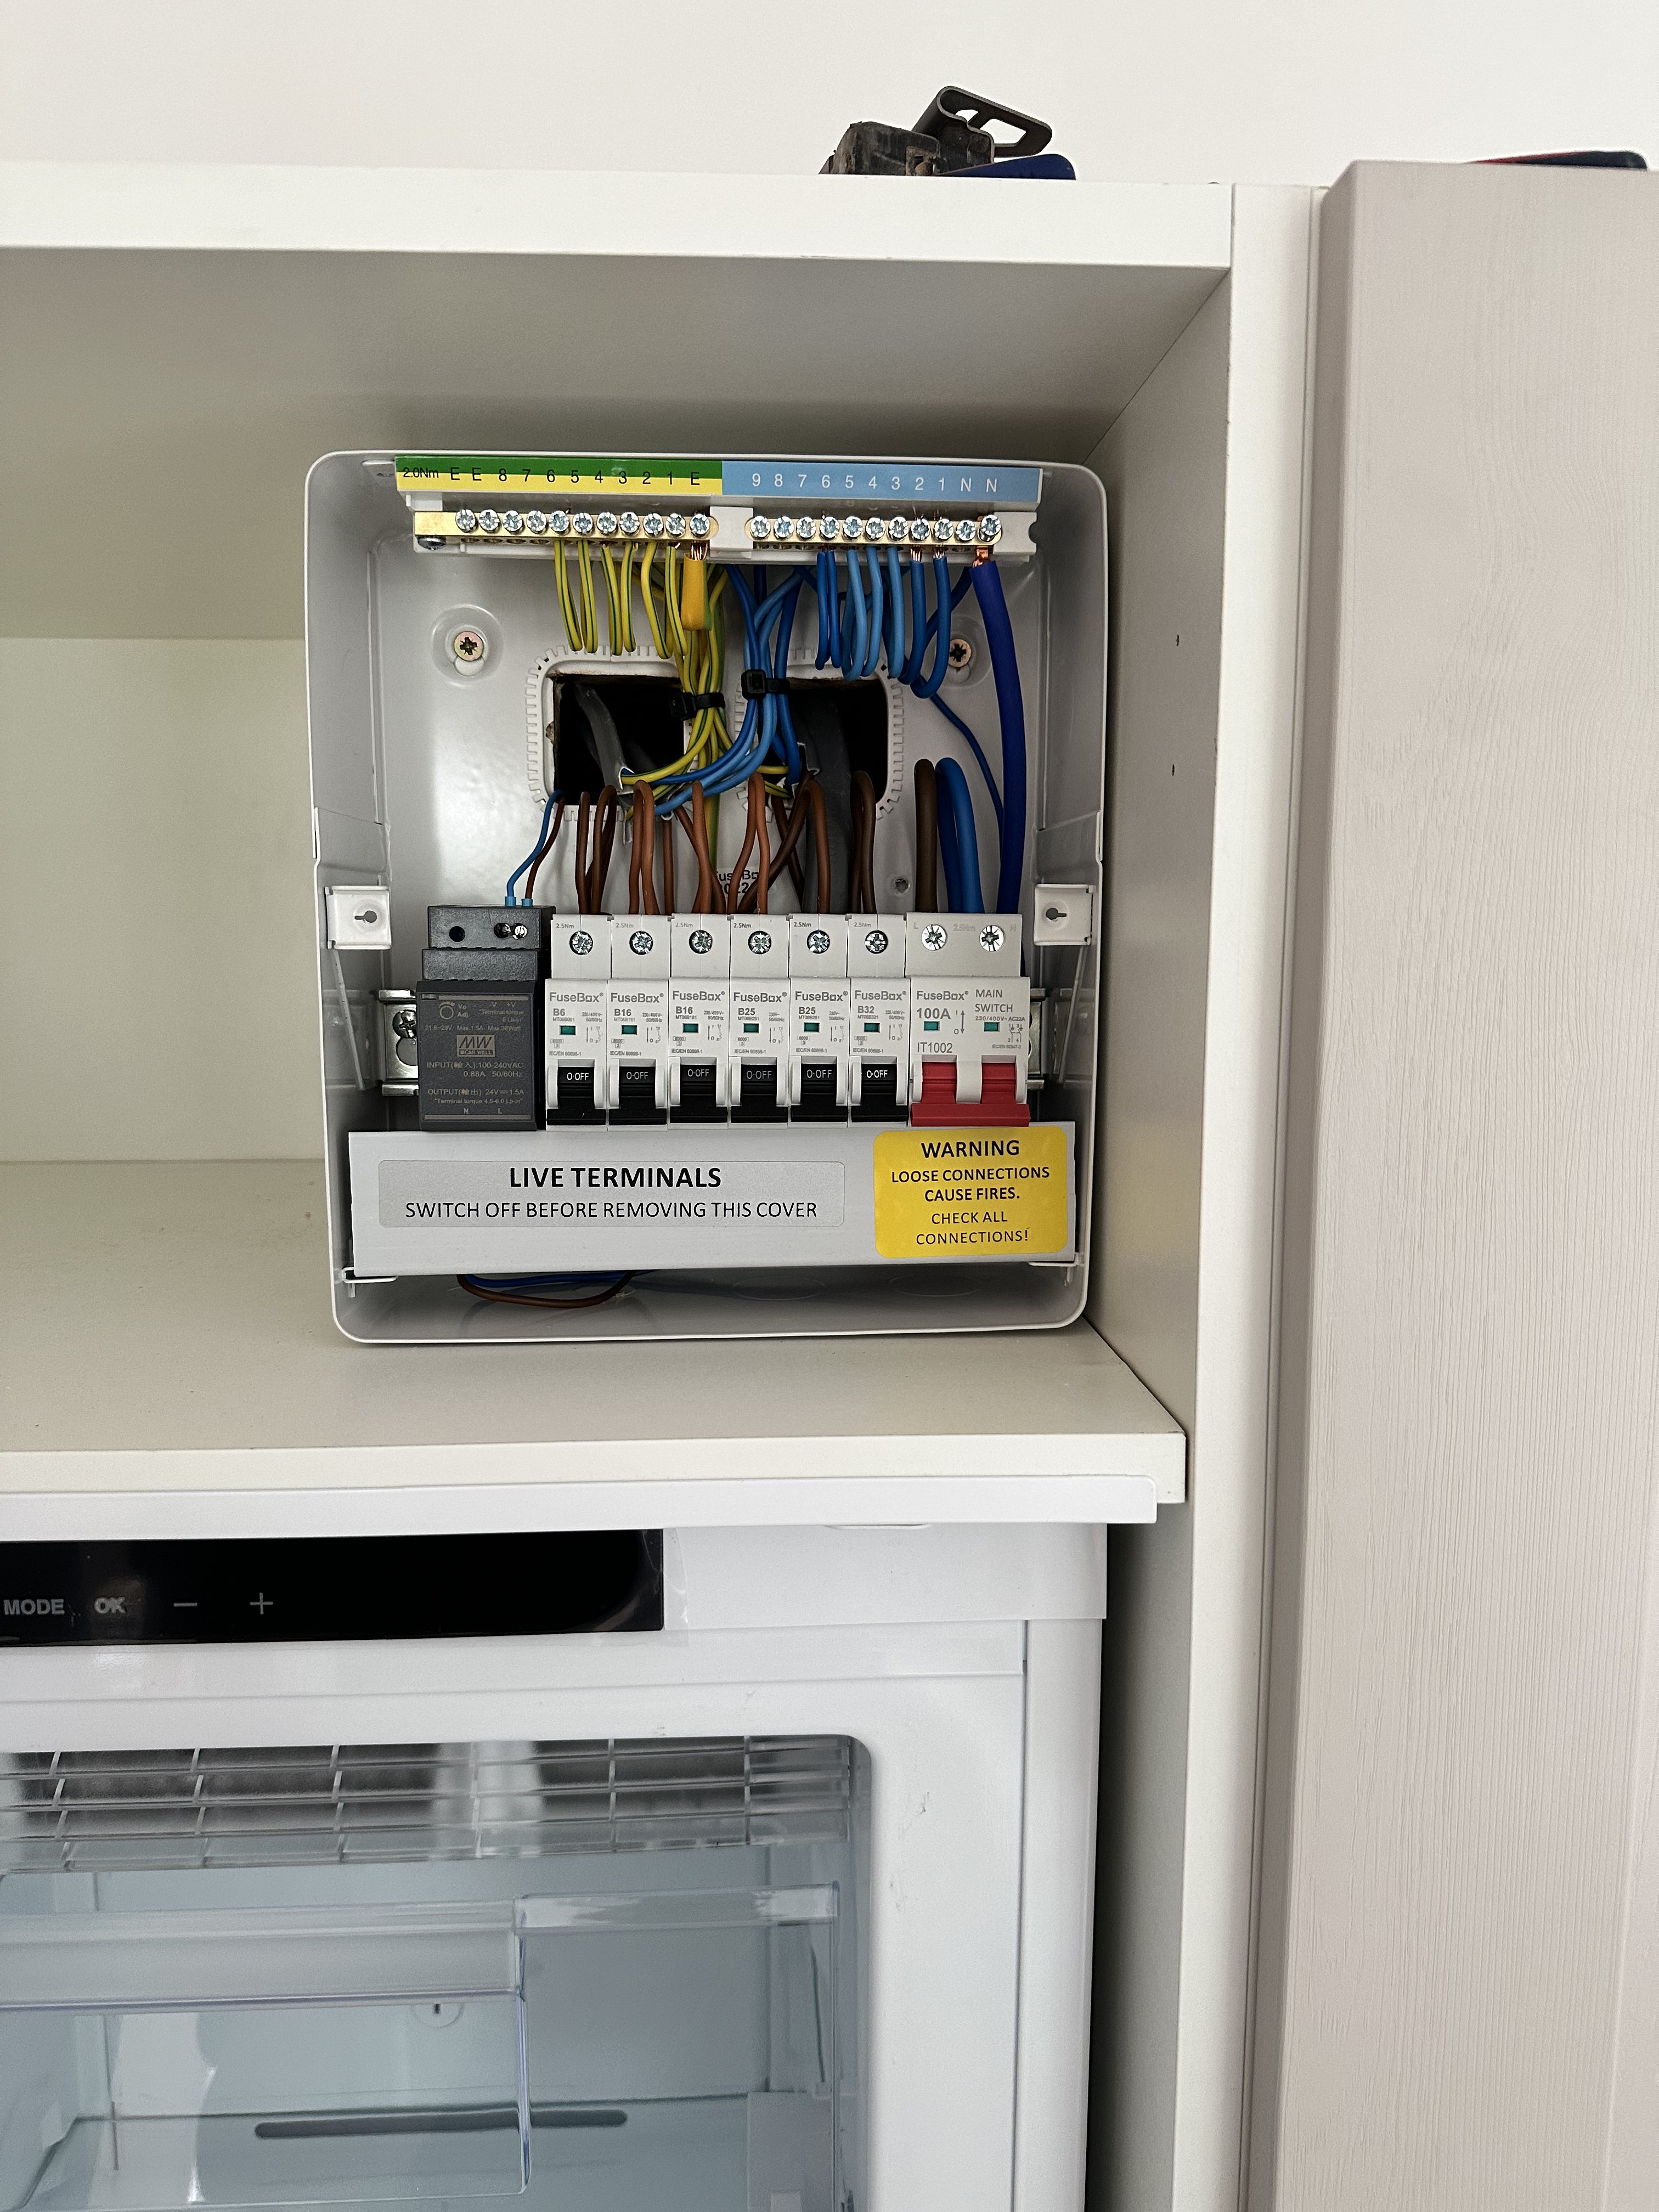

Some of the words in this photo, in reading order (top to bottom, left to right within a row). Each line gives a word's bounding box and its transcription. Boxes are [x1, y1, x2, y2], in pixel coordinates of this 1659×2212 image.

[403, 467, 439, 479] 2.0Nm
[450, 467, 460, 481] E
[472, 467, 482, 481] E
[498, 469, 507, 482] 8
[522, 469, 531, 482] 7
[546, 470, 555, 483] 6
[571, 470, 579, 483] 5
[595, 470, 604, 484] 4
[618, 471, 628, 484] 3
[642, 471, 651, 484] 2
[668, 472, 674, 484] 1
[691, 472, 699, 485] E
[752, 473, 761, 487] 9
[774, 474, 783, 487] 8
[798, 475, 807, 488] 7
[822, 475, 830, 488] 6
[845, 476, 854, 489] 5
[868, 476, 877, 489] 4
[891, 477, 900, 490] 3
[915, 477, 924, 491] 2
[939, 477, 945, 491] 1
[961, 478, 972, 492] N
[986, 478, 997, 492] N
[975, 989, 1003, 998] MAIN
[614, 1008, 632, 1017] B16
[676, 1006, 693, 1014] B16
[857, 1006, 874, 1014] B32
[916, 1008, 951, 1019] 100A
[975, 1003, 1013, 1012] SWITCH
[459, 1036, 493, 1048] MW
[917, 1042, 953, 1053] IT1002
[921, 1139, 1019, 1159] WARNING
[510, 1167, 563, 1187] LIVE
[571, 1167, 721, 1187] TERMINALS
[891, 1170, 939, 1183] LOOSE
[943, 1167, 1049, 1181] CONNECTIONS
[925, 1189, 972, 1201] CAUSE
[977, 1187, 1020, 1200] FIRES.
[405, 1202, 479, 1218] SWITCH
[486, 1202, 520, 1218] OFF
[527, 1202, 597, 1218] BEFORE
[604, 1202, 706, 1217] REMOVING
[712, 1202, 751, 1217] THIS
[757, 1202, 817, 1217] COVER
[932, 1212, 978, 1224] CHECK
[983, 1211, 1008, 1223] ALL
[916, 1229, 1029, 1245] CONNECTIONS!
[3, 1598, 65, 1615] MODE
[94, 1597, 126, 1614] OK
